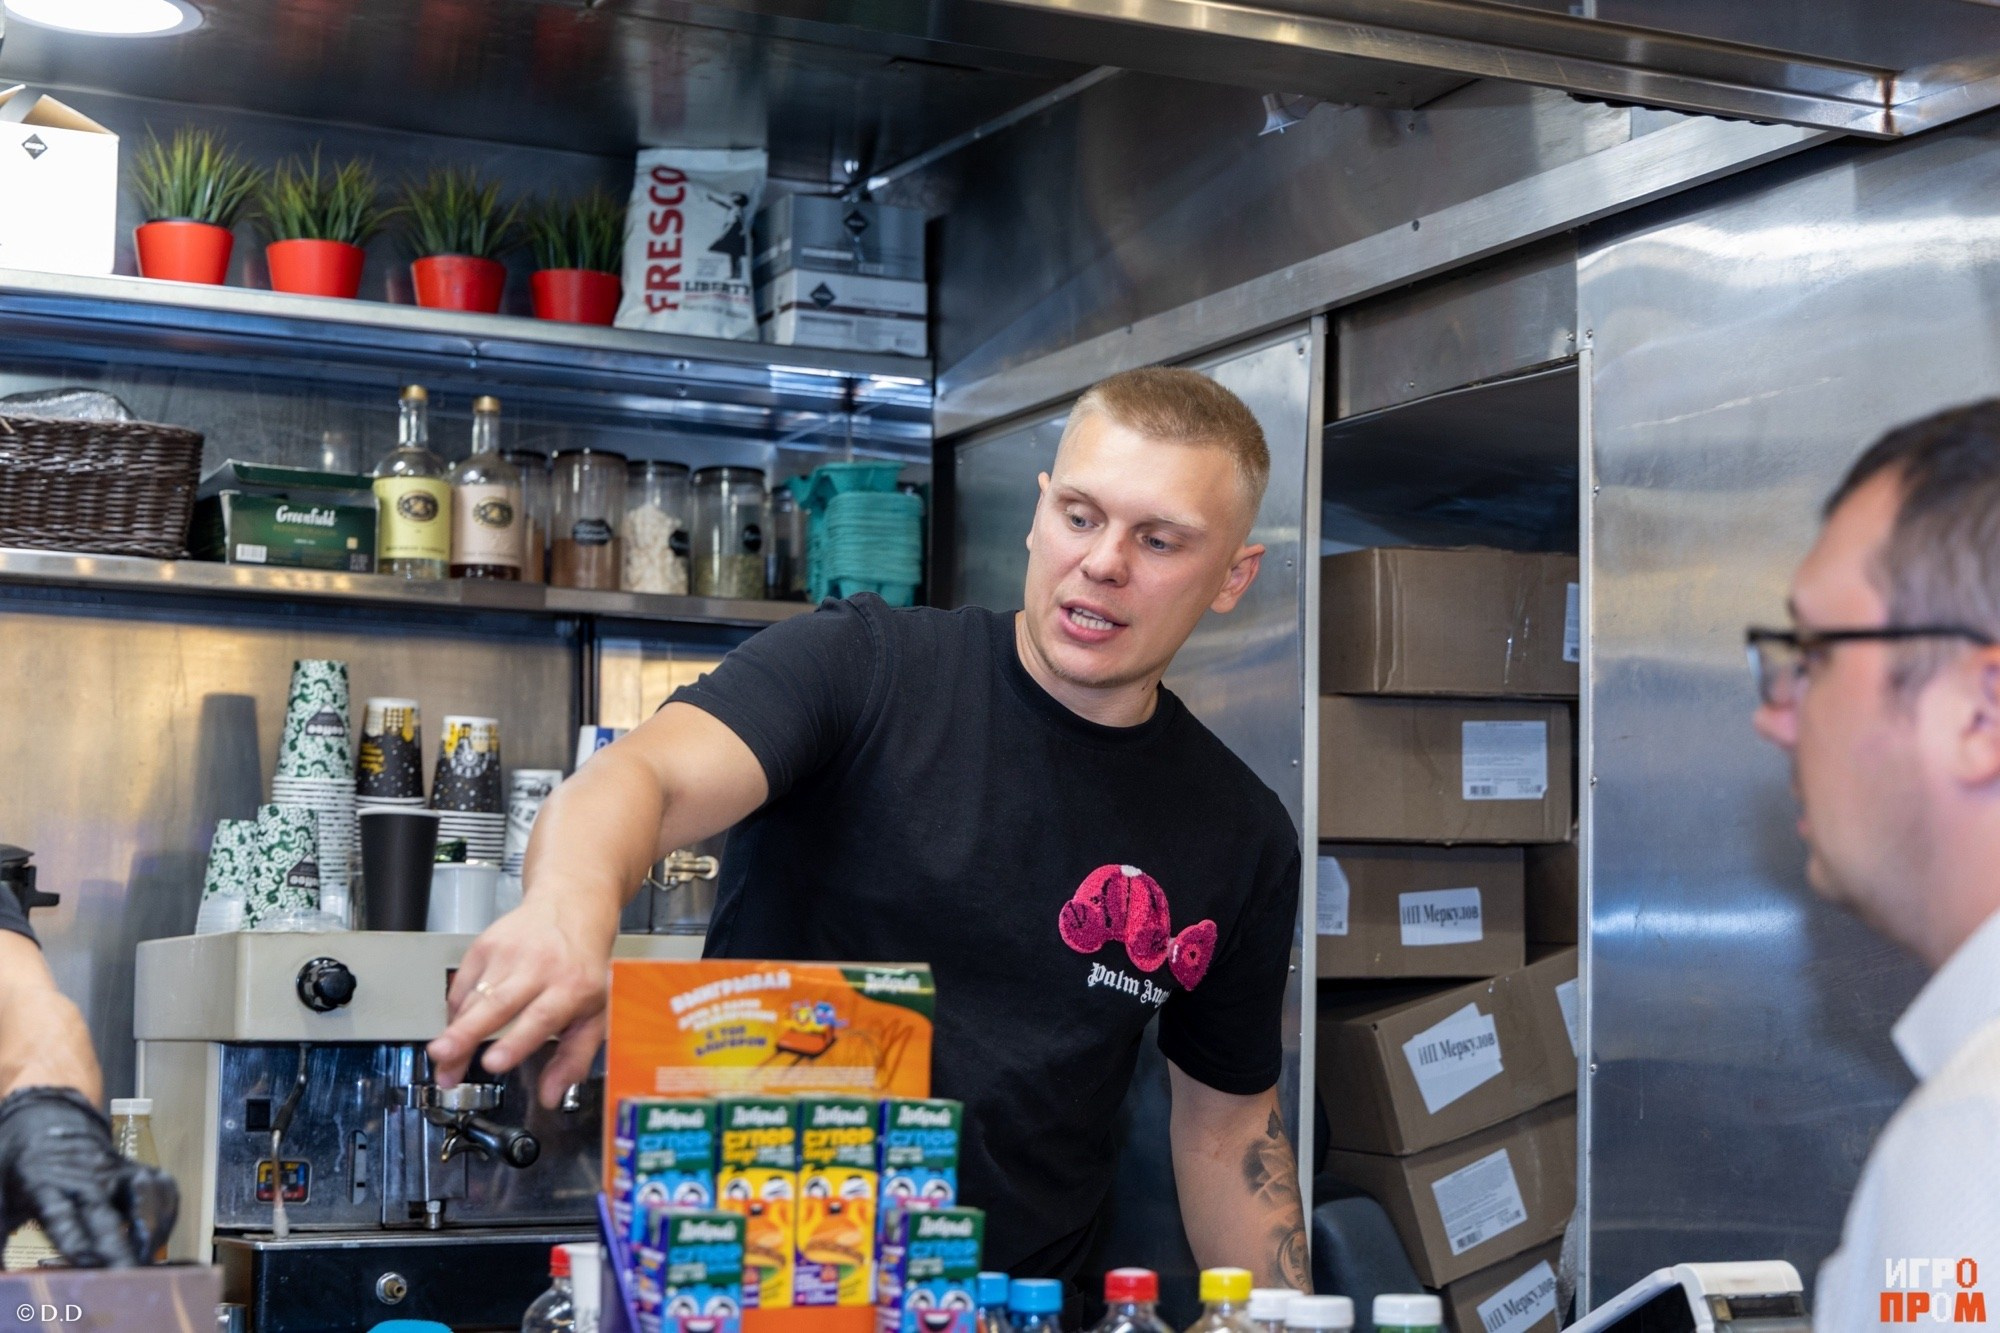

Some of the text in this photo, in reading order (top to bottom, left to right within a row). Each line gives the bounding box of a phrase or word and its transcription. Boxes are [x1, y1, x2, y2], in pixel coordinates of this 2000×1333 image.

[644, 165, 688, 314] FRESCO
[276, 504, 337, 527] Greenfield
[1087, 962, 1140, 996] Palm
